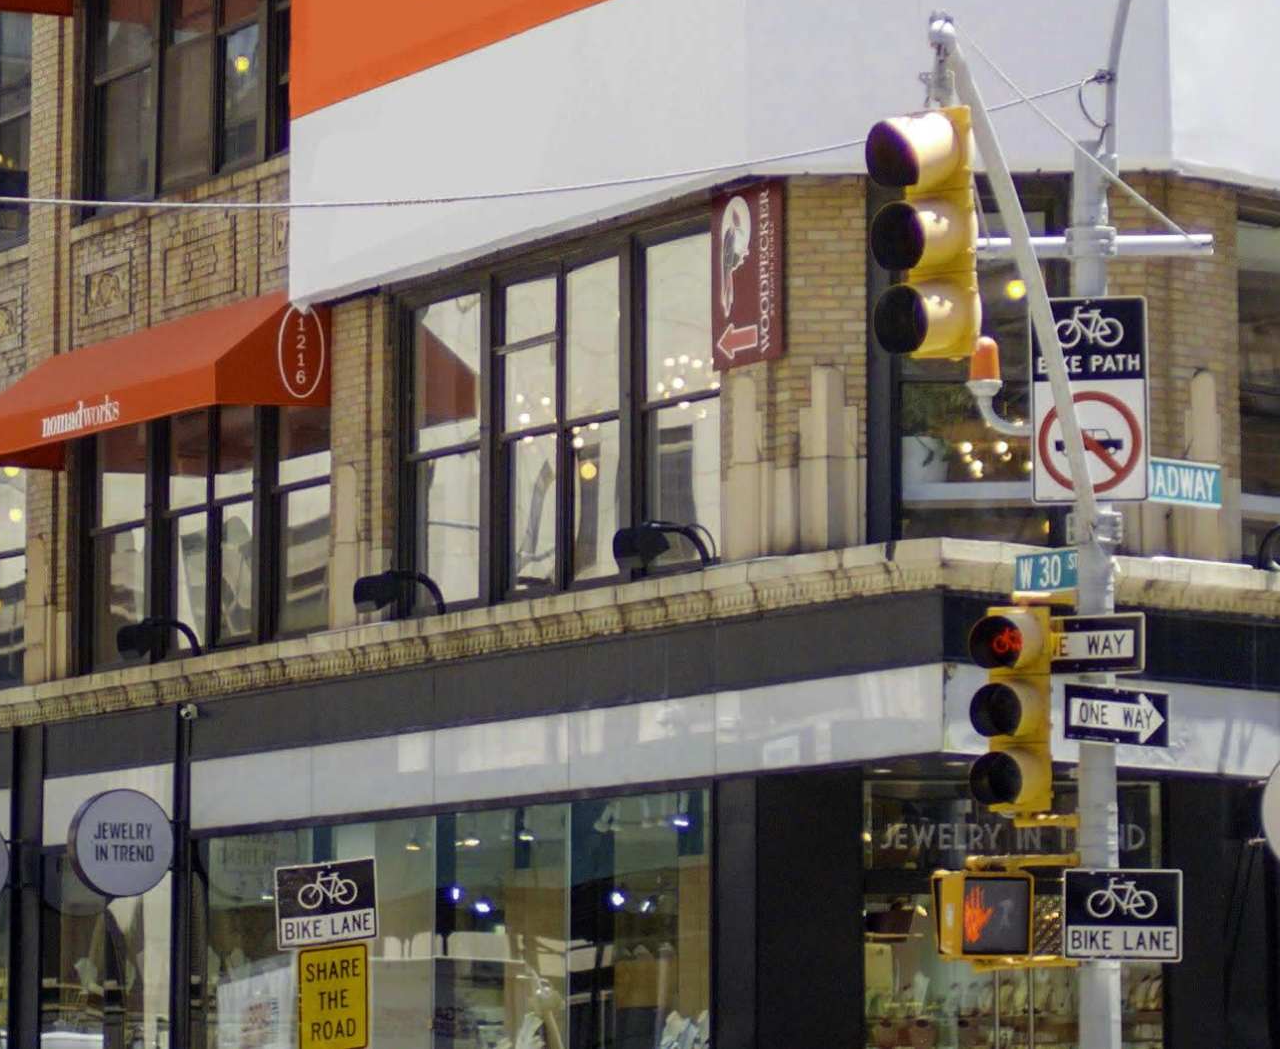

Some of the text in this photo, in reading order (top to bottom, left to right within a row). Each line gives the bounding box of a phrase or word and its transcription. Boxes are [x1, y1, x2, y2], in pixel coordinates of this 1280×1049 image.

[758, 189, 770, 354] WOODPECKER
[294, 317, 307, 385] 1216
[1037, 353, 1141, 374] BKE PATH
[41, 394, 120, 438] nomadworks
[1149, 465, 1217, 502] ADWAY
[1020, 557, 1034, 590] W
[1039, 554, 1062, 587] 30
[1087, 633, 1126, 656] WAY
[1078, 702, 1154, 728] ONE WAY
[94, 822, 153, 841] JEWELRY
[880, 823, 1004, 850] JEWELRY
[1016, 827, 1041, 851] IN
[95, 845, 154, 863] IN TREND
[285, 912, 372, 940] BIKE LANE
[1070, 929, 1175, 952] BIKE LANE
[305, 958, 361, 982] SHARE
[317, 989, 349, 1010] THE
[311, 1018, 357, 1042] ROAD
